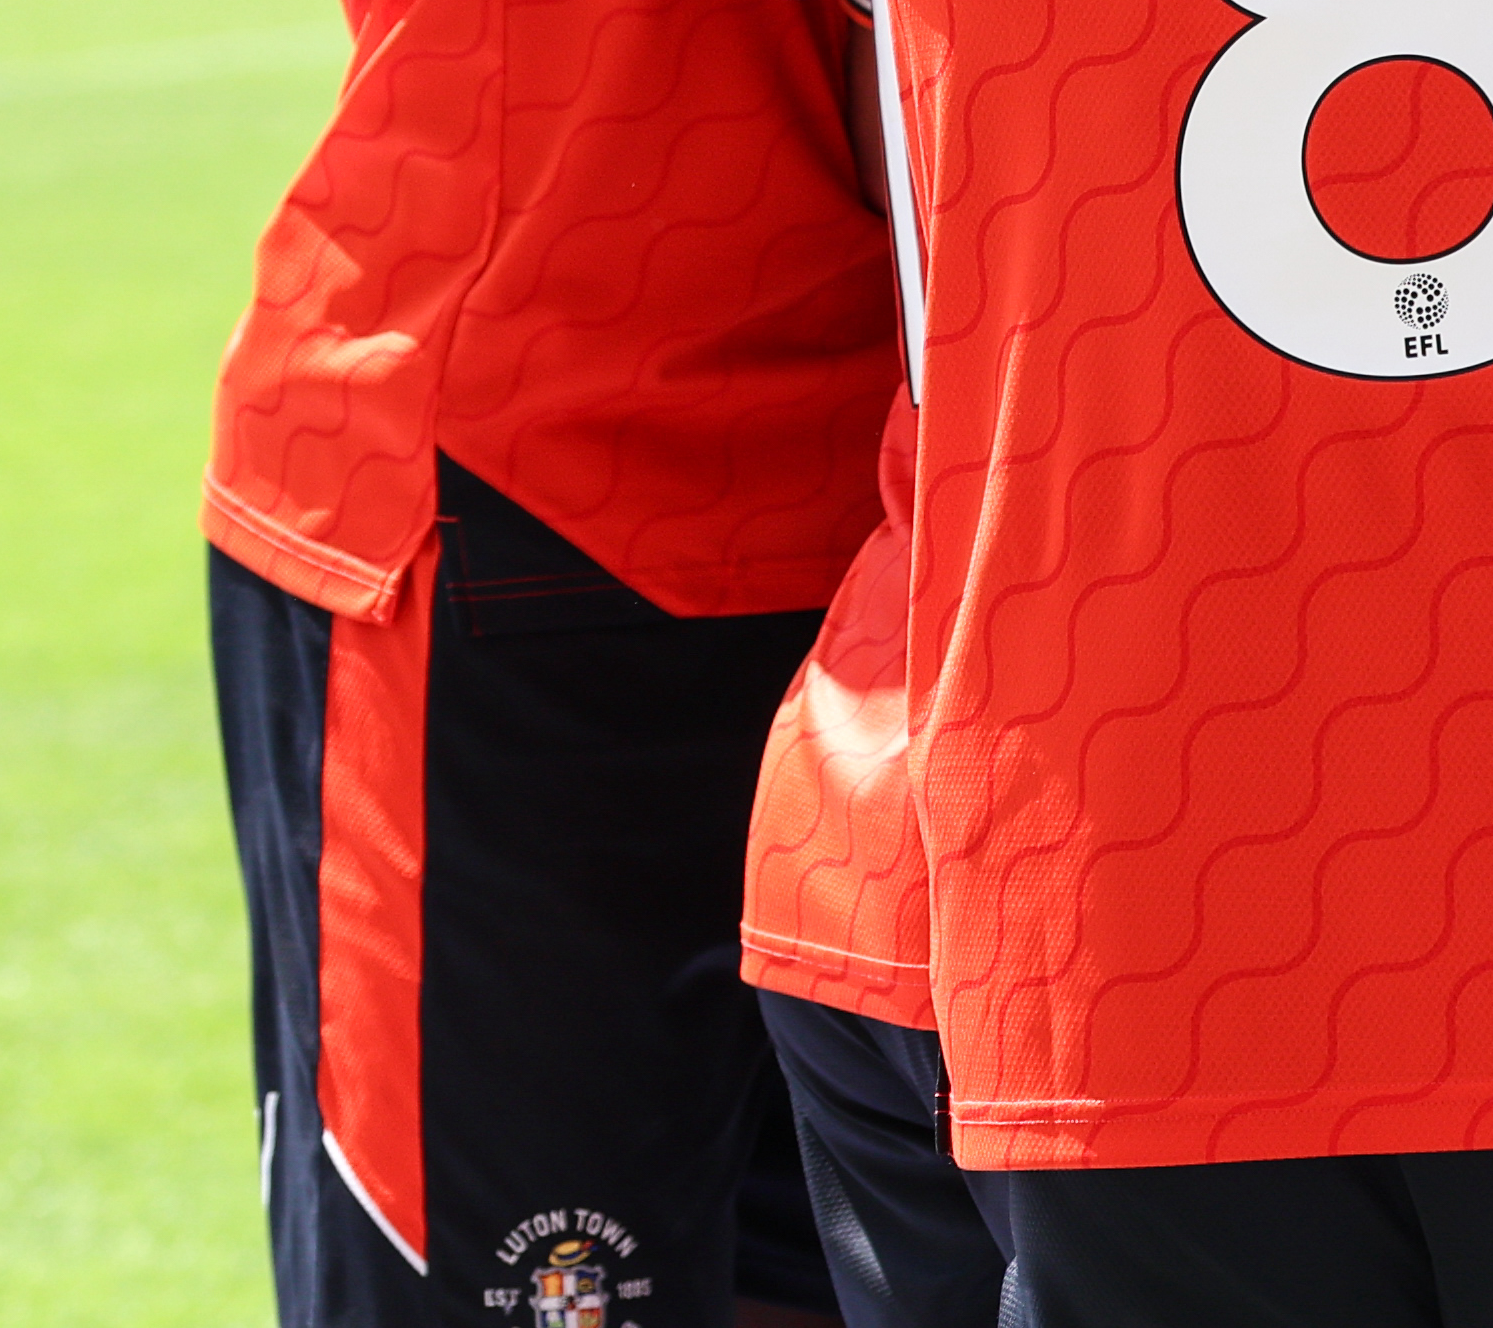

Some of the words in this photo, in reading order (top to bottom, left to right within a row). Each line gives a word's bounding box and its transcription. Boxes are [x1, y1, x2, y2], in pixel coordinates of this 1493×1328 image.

[1404, 333, 1449, 359] EFL
[495, 1208, 568, 1266] LUTON
[573, 1207, 639, 1259] TOWN
[483, 1288, 522, 1309] EST
